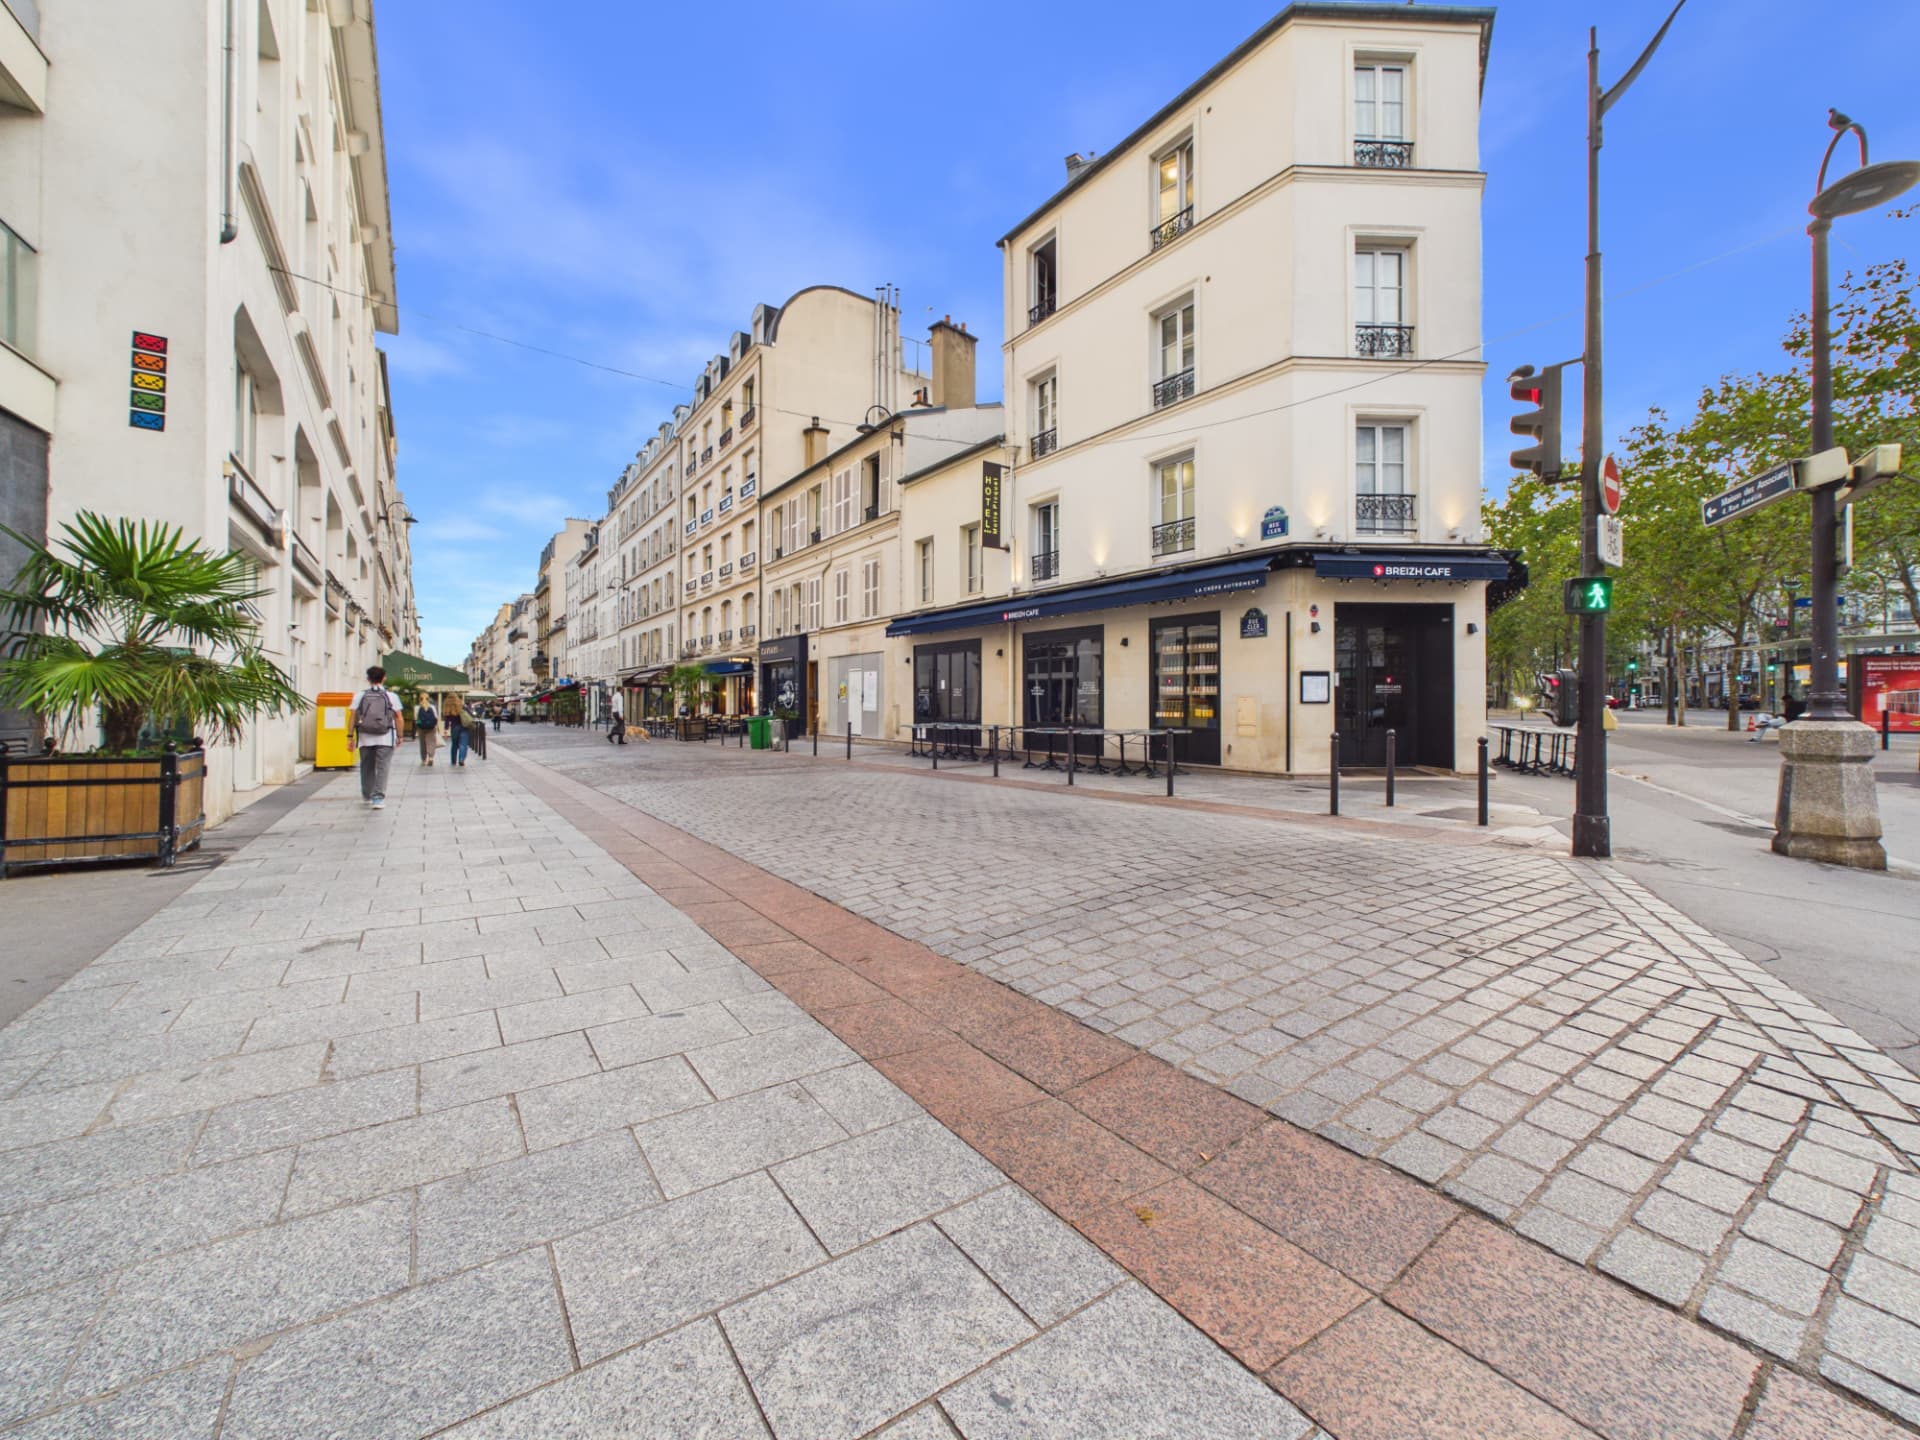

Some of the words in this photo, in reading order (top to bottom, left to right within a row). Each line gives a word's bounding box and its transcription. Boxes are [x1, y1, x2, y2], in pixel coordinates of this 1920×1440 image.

[1721, 492, 1742, 507] Maison
[1385, 566, 1422, 575] BREIZH
[1424, 567, 1451, 576] CAFE
